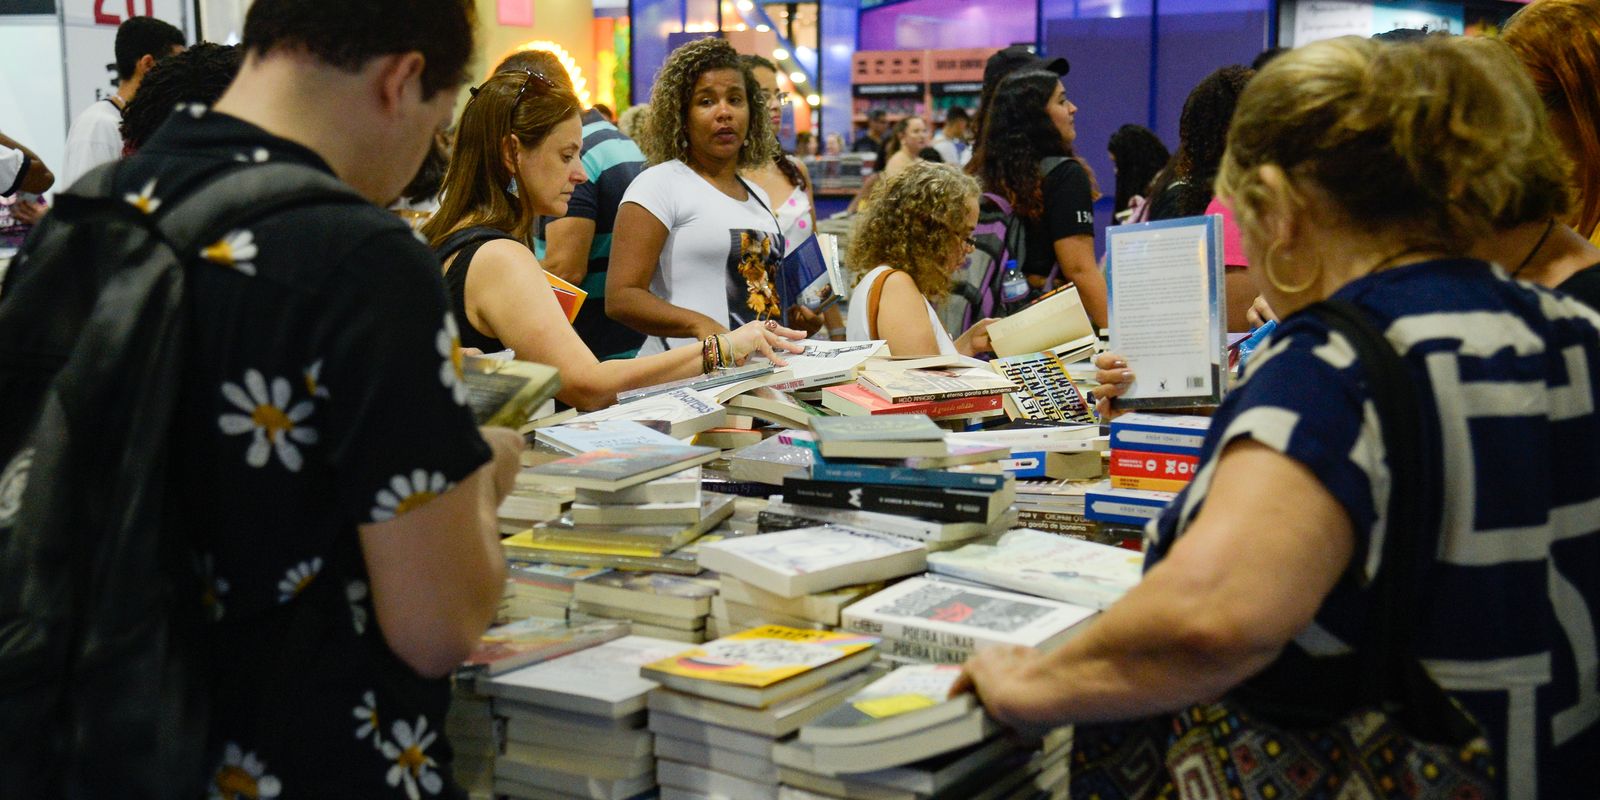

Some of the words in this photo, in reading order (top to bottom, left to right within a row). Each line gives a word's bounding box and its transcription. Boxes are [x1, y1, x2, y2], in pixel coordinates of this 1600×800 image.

[965, 389, 981, 397] garota
[902, 625, 937, 643] POEIRA
[941, 631, 975, 648] LUNAR
